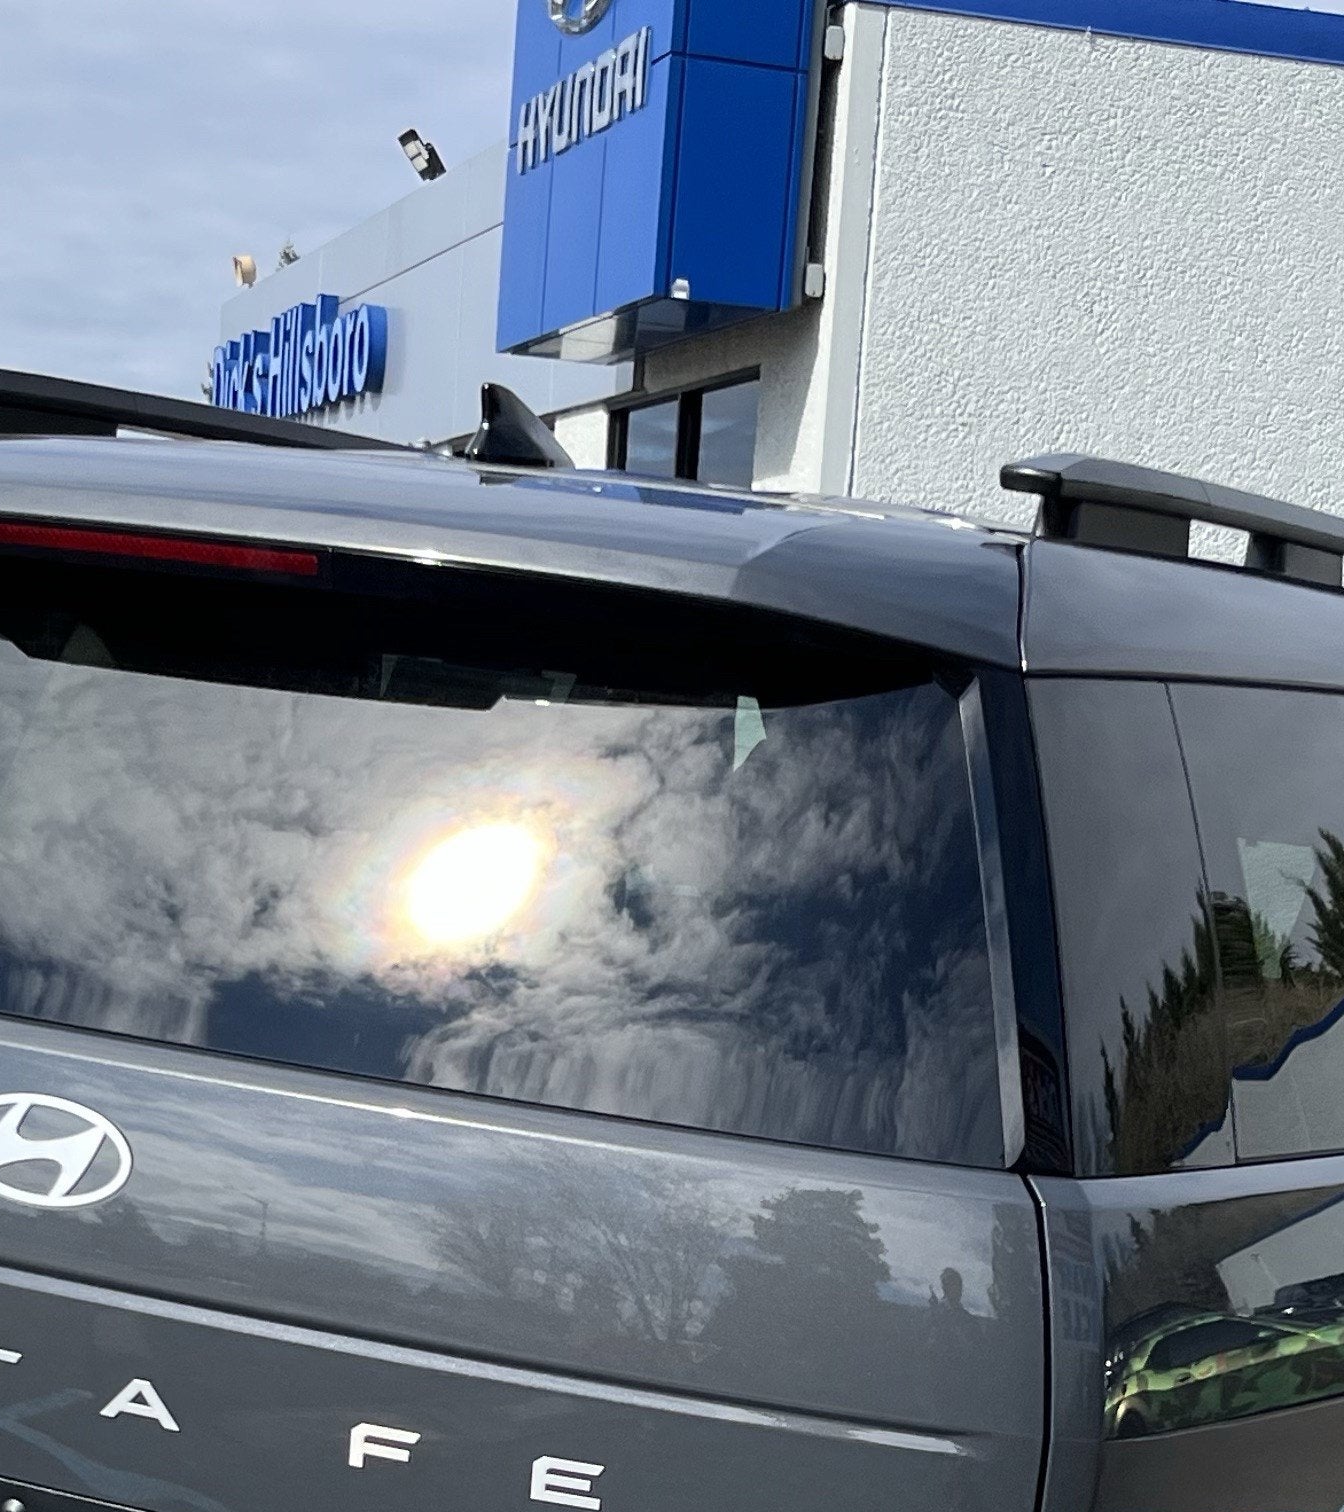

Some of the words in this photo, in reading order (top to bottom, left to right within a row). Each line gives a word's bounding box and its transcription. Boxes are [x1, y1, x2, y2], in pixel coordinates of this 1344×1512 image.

[517, 25, 652, 175] HYUNDAI
[267, 294, 373, 419] Hillsboro
[348, 1422, 605, 1511] FE
